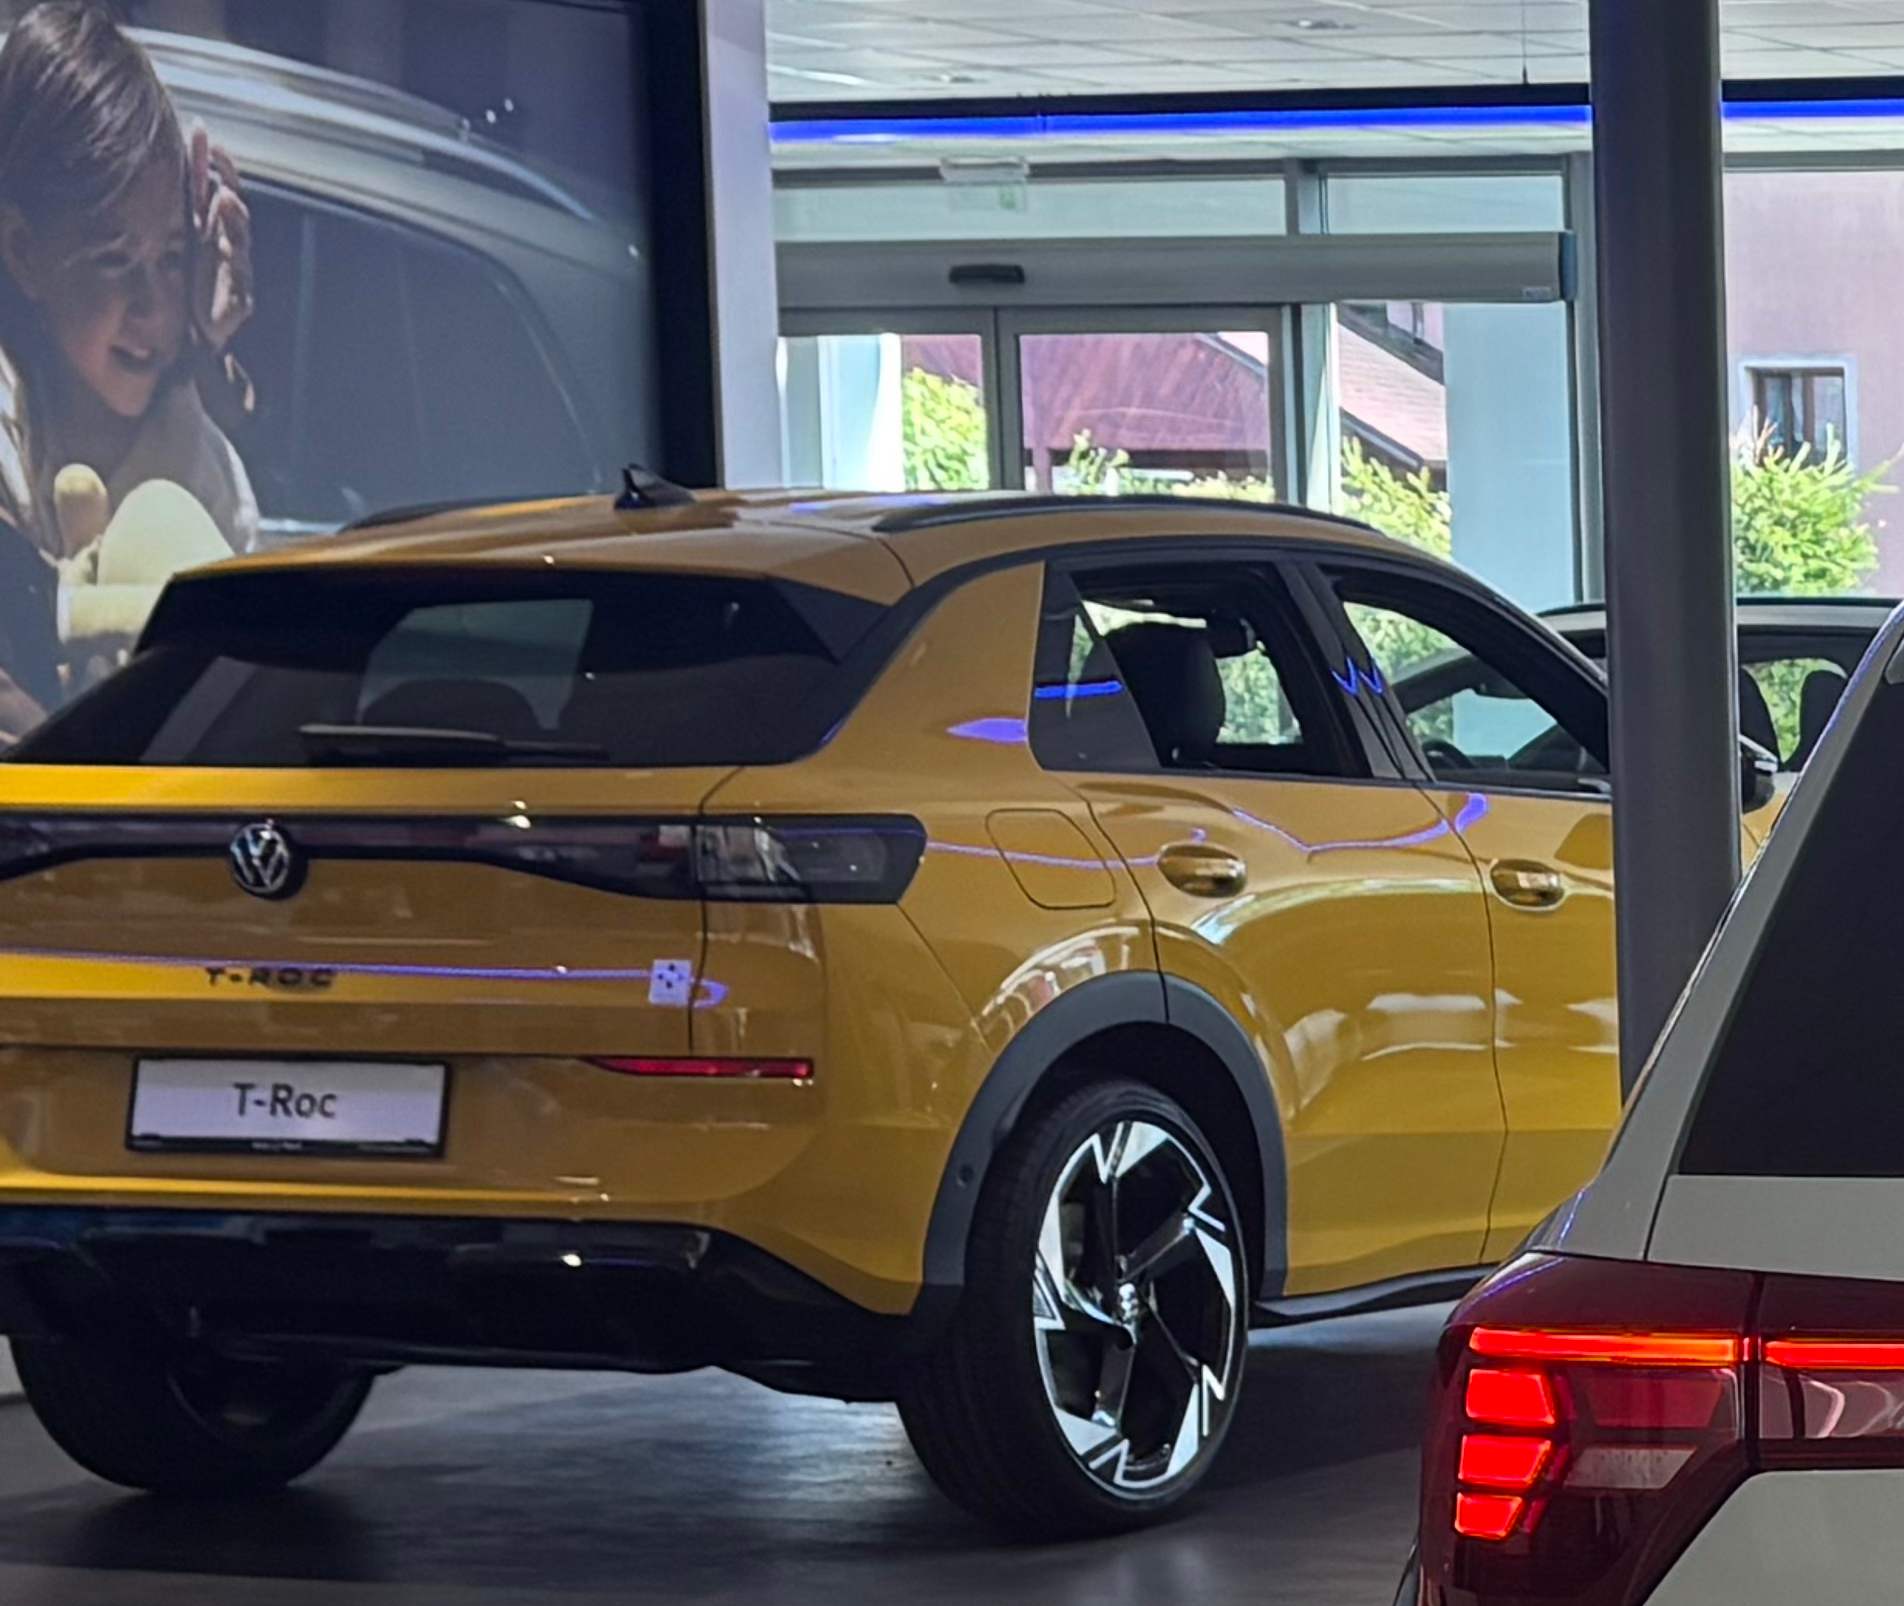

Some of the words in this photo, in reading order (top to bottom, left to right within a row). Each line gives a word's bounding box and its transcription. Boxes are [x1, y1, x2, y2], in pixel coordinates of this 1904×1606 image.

[230, 824, 289, 892] VW
[205, 966, 335, 987] T-ROC
[233, 1083, 338, 1118] T-Roc
